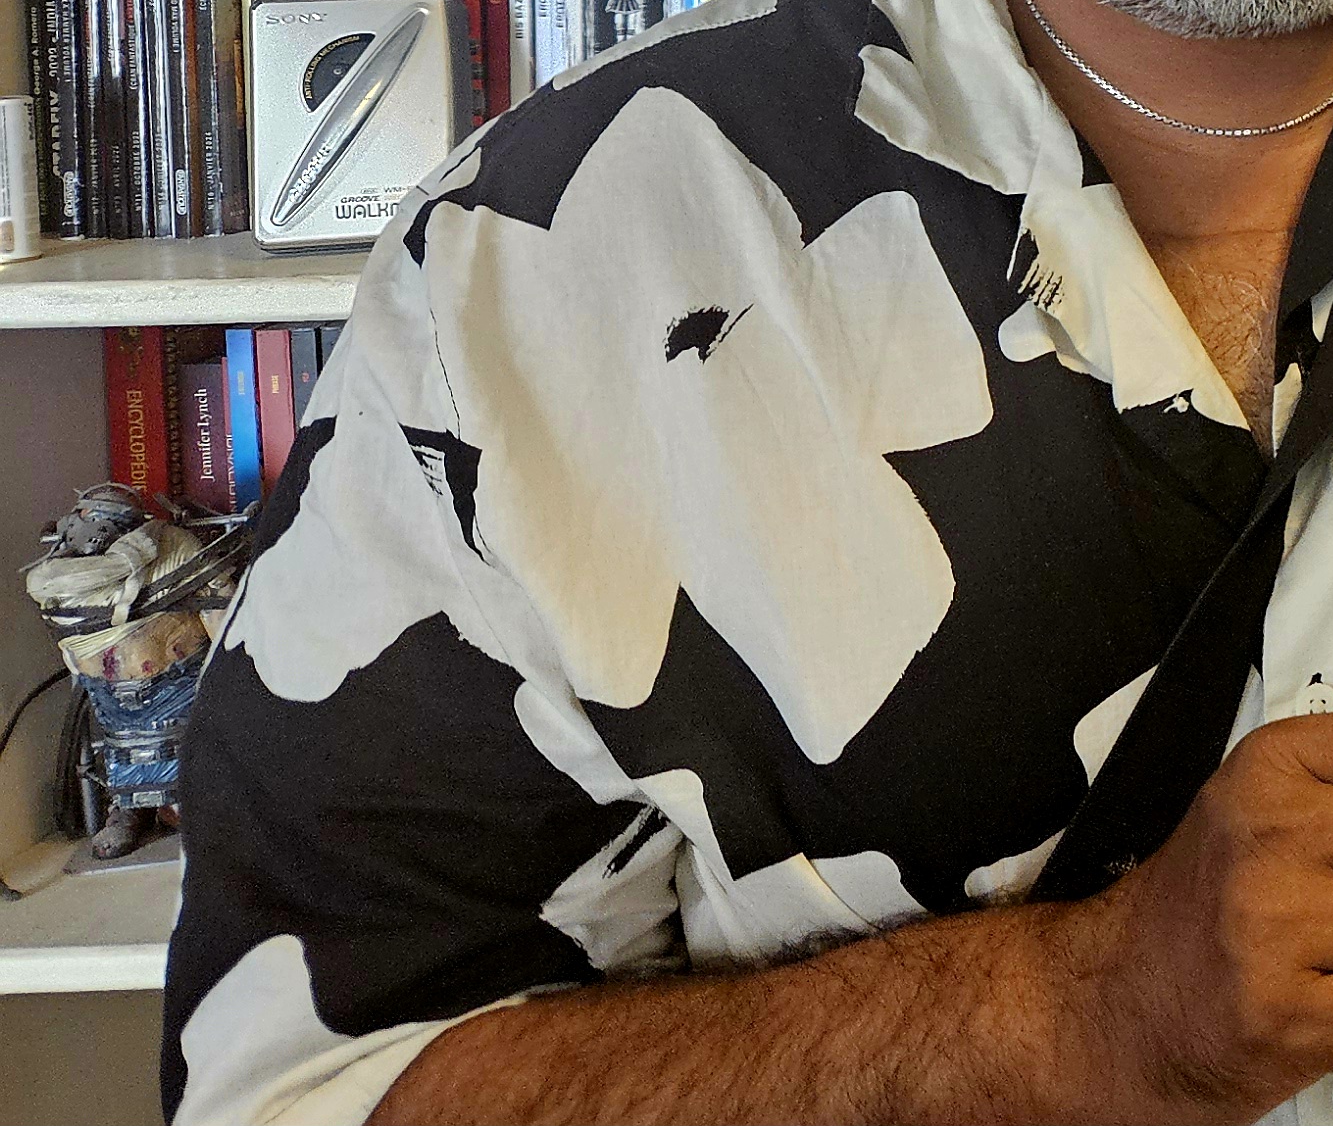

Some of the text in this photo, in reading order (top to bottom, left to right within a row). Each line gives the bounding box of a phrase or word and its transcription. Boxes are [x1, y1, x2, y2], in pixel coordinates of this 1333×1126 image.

[266, 12, 327, 24] SONY
[193, 388, 215, 482] Jennifer Lynch
